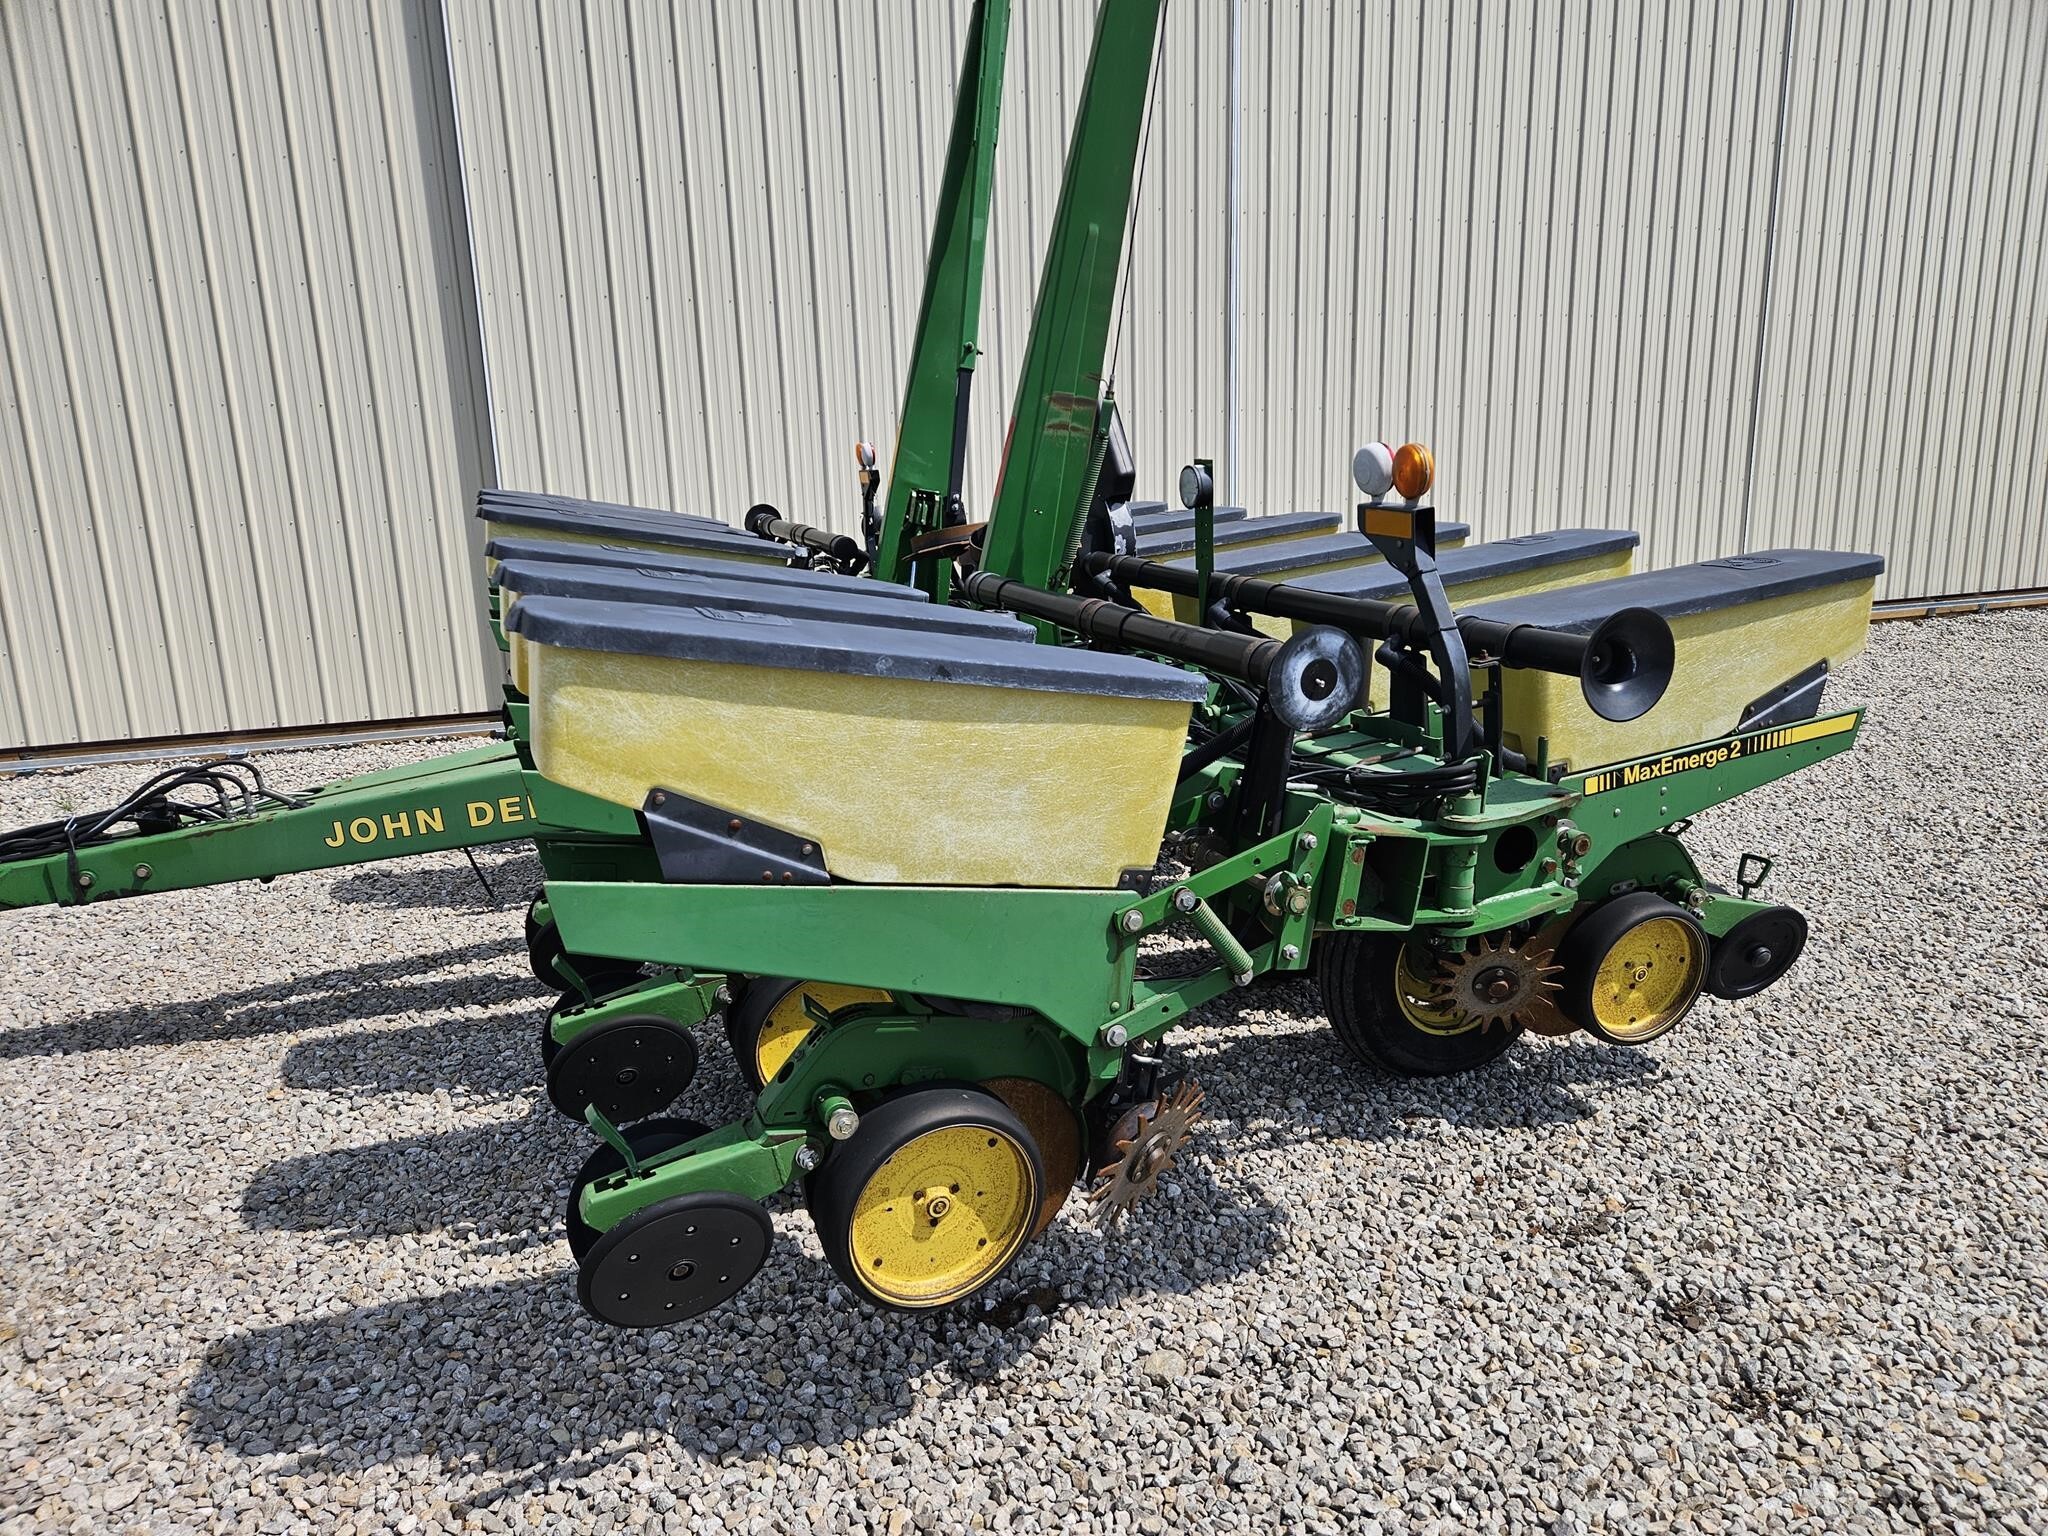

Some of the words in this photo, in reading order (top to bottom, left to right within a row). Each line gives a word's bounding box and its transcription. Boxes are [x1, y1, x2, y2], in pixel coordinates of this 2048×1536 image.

[1623, 747, 1728, 786] MaxEmerge
[1729, 740, 1741, 760] 2
[324, 806, 445, 848] JOHN
